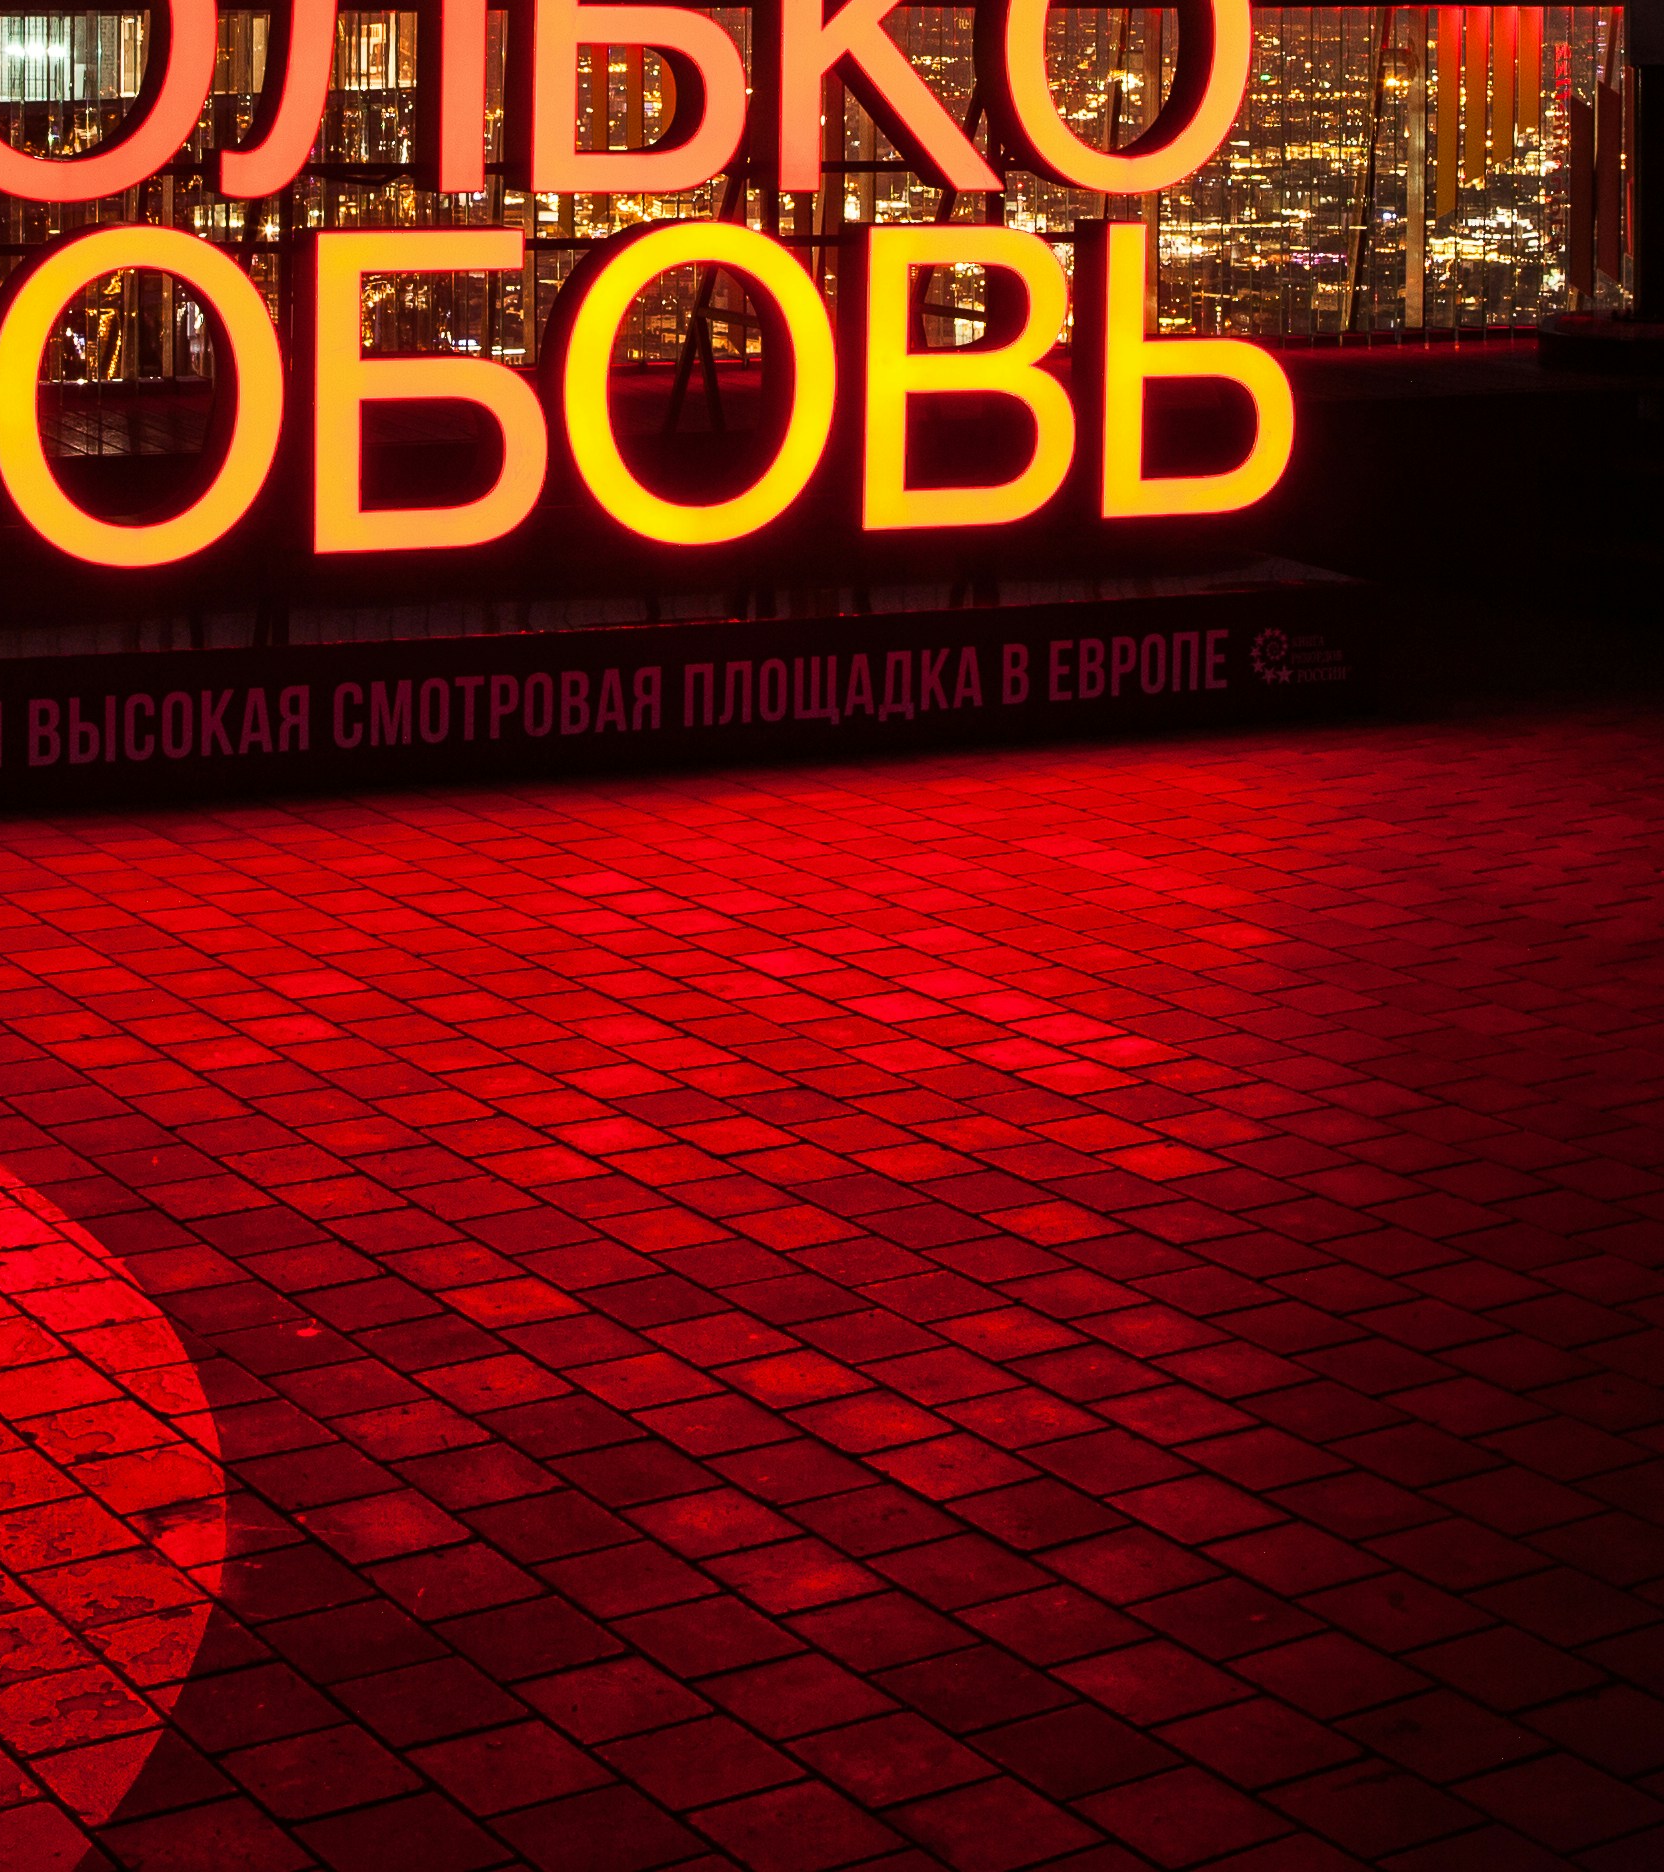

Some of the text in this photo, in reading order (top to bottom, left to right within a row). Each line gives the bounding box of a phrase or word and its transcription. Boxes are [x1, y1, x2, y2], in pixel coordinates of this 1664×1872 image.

[28, 684, 310, 767] ВЫСОКАЯ
[334, 665, 664, 749] СМОТРОВАЯ
[684, 645, 983, 727] ПЛОЩАДКА
[1001, 642, 1031, 706] В
[1048, 628, 1229, 702] ЕВРОПЕ
